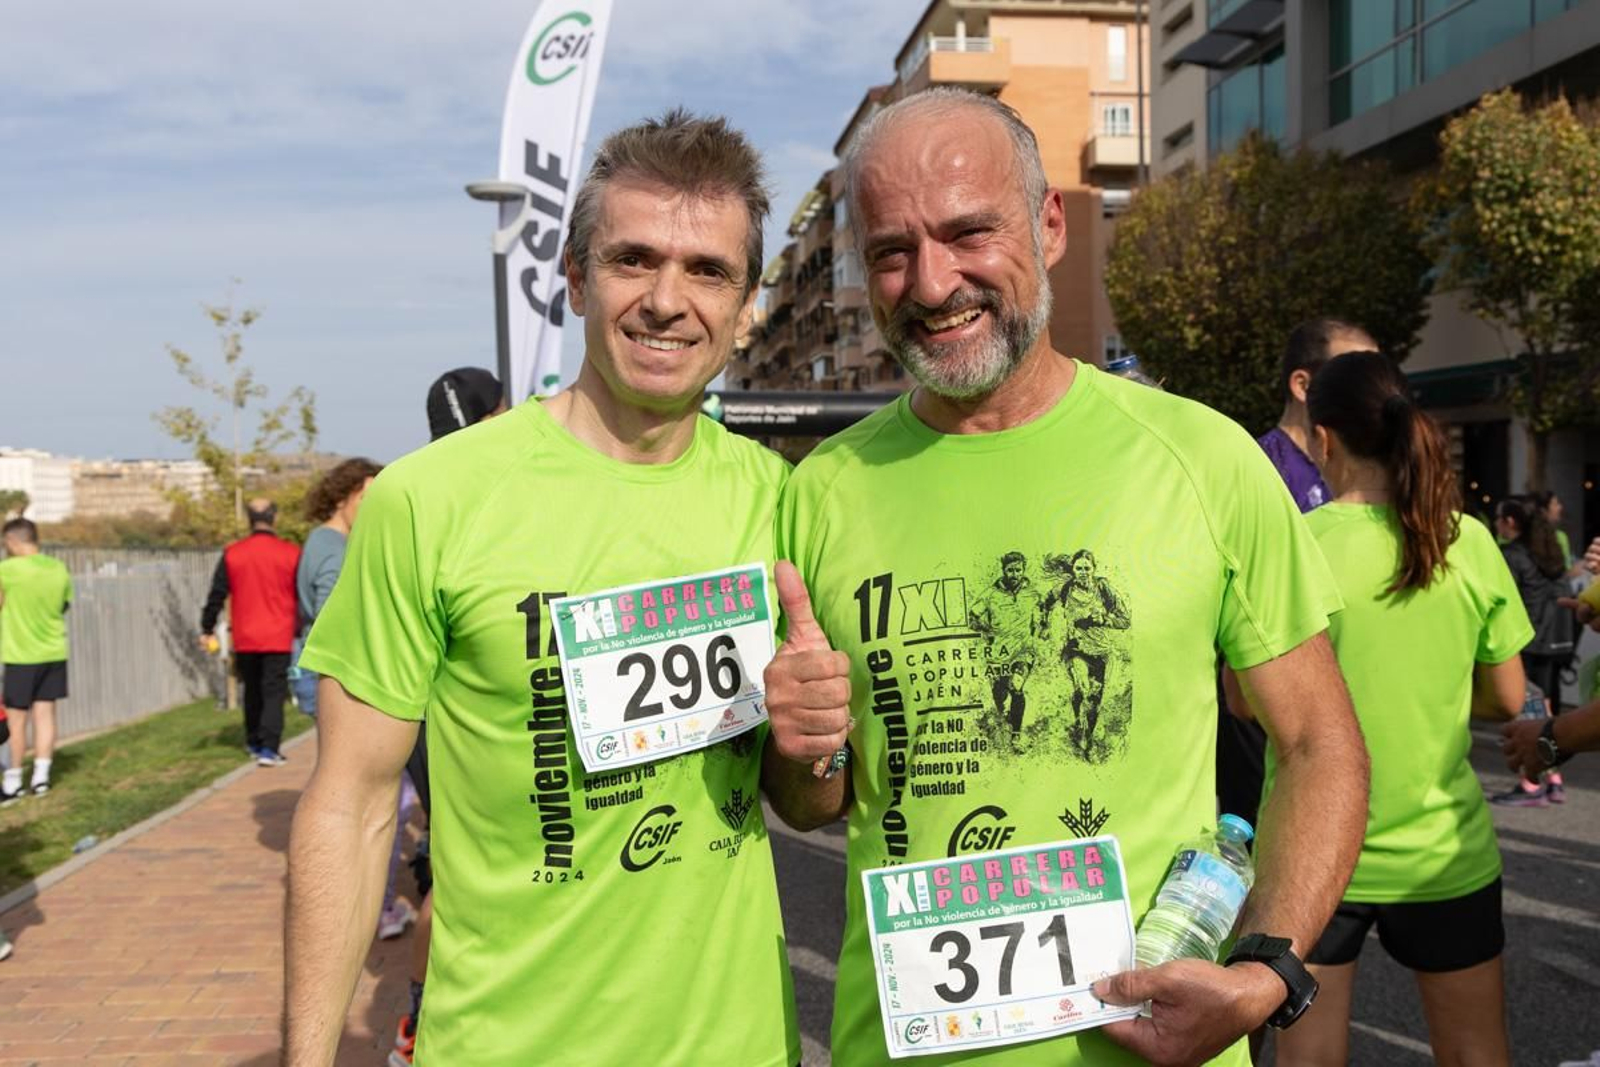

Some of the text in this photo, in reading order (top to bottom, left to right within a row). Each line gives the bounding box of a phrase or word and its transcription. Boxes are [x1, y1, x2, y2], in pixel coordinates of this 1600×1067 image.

[618, 574, 752, 612] CARRERA
[898, 577, 969, 635] XI
[569, 598, 617, 643] XI
[621, 592, 755, 633] POPULAR
[854, 572, 893, 643] 17
[582, 645, 598, 656] por
[627, 632, 665, 645] violencia
[666, 628, 676, 637] de
[678, 623, 706, 637] género
[707, 622, 713, 630] y
[714, 620, 722, 628] la
[723, 612, 755, 627] igualdad
[906, 645, 1010, 667] CARRERA
[617, 633, 741, 722] 296
[910, 663, 1011, 685] POPULAR
[914, 683, 962, 702] JAÉN
[932, 720, 944, 733] la
[947, 718, 963, 733] NO
[601, 741, 618, 753] CSIF
[867, 648, 909, 858] noviembre
[970, 738, 987, 752] de
[528, 667, 575, 869] noviembre
[584, 765, 656, 792] género y la
[910, 760, 980, 778] género y la
[585, 786, 643, 810] igualdad
[911, 780, 965, 798] igualdad
[634, 821, 683, 851] CSIF
[709, 836, 732, 851] CAJA
[960, 826, 1016, 850] CSIF
[663, 855, 682, 865] Jaén
[933, 846, 1103, 887] CARRERA
[532, 870, 584, 883] 2024
[935, 867, 1105, 909] POPULAR
[881, 870, 932, 916] XI
[893, 889, 1104, 931] por la No violencia de género y la igualdad
[881, 943, 894, 965] 2024
[928, 914, 1076, 1003] 371
[909, 1024, 929, 1036] CSIF
